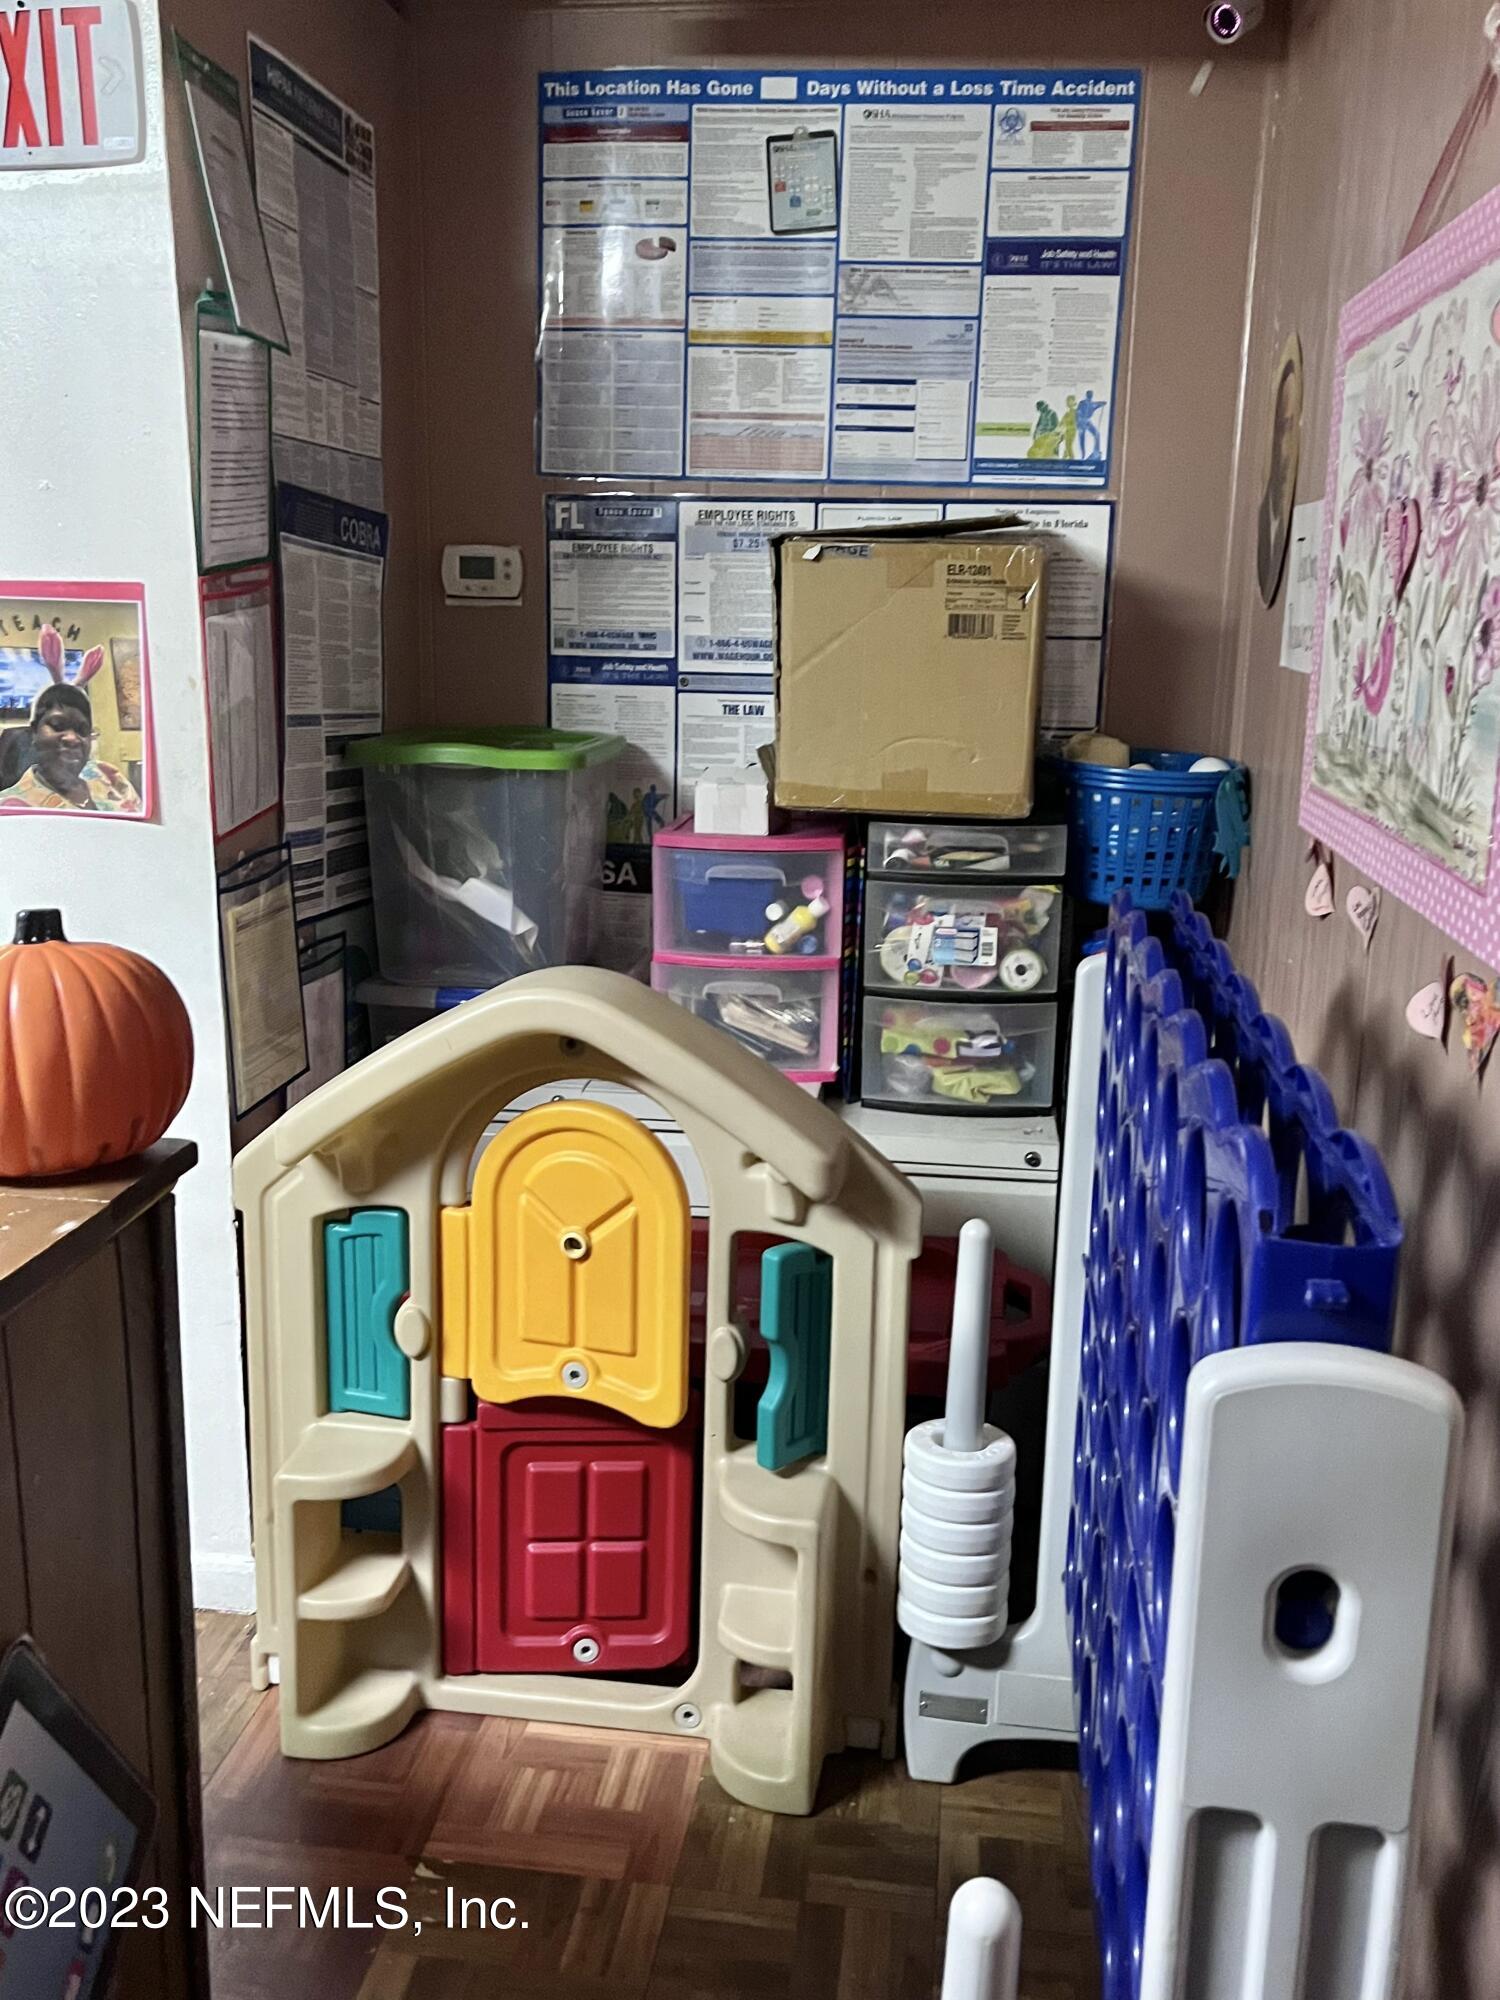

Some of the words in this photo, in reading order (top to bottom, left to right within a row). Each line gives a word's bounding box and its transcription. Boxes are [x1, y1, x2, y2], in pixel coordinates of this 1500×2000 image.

[544, 81, 579, 98] This
[585, 80, 660, 97] Location
[666, 79, 701, 97] Has
[706, 79, 754, 97] Gone
[806, 80, 851, 99] Days
[856, 79, 927, 97] Without
[932, 83, 945, 97] a
[951, 80, 994, 97] Loss
[1000, 79, 1046, 97] Time
[1051, 79, 1136, 97] Accident
[555, 501, 585, 531] FL
[698, 509, 754, 522] EMPLOYEE
[757, 510, 796, 522] RIGHTS
[1054, 519, 1089, 529] Florida
[341, 516, 381, 550] COBRA
[572, 543, 619, 553] EMPLOYEE
[620, 543, 654, 554] RIGHTS
[722, 704, 740, 715] THE
[743, 704, 766, 716] LAW
